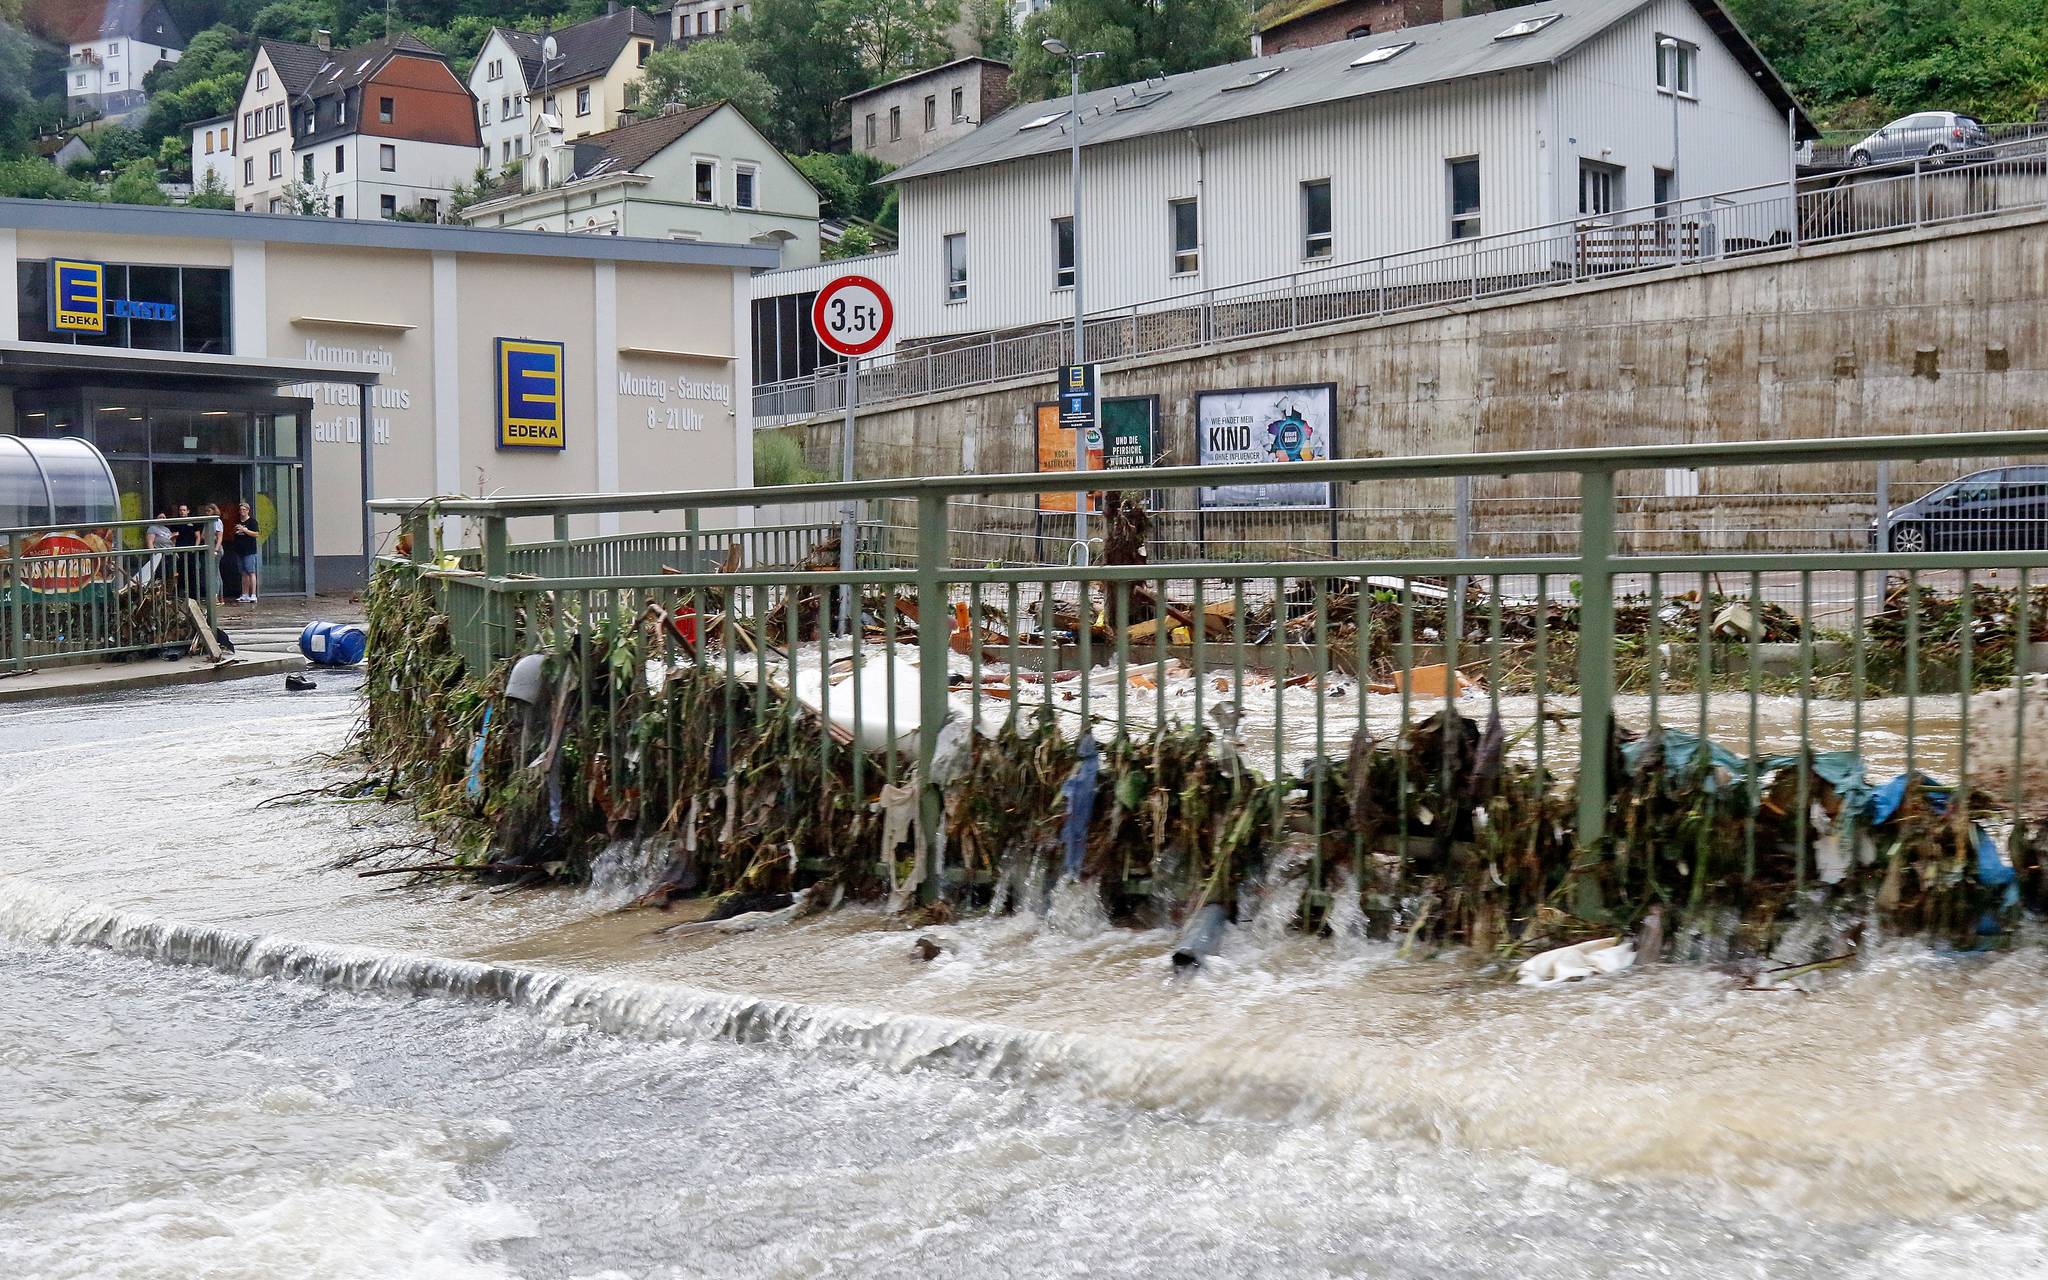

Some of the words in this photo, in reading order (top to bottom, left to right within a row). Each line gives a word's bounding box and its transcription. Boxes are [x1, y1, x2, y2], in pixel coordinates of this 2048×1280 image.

[60, 315, 99, 326] EDEKA
[305, 339, 358, 365] Komm
[362, 345, 396, 376] rein,
[619, 371, 666, 403] Montag
[678, 376, 730, 407] Samstag
[381, 388, 410, 410] uns
[647, 407, 656, 429] 8
[666, 408, 680, 430] 21
[682, 408, 704, 432] Uhr
[1211, 417, 1221, 425] WIE
[1222, 416, 1239, 425] FINDET
[1240, 415, 1254, 423] MEIN
[315, 416, 342, 443] auf
[508, 424, 558, 438] EDEKA
[1115, 436, 1128, 445] UND
[1128, 435, 1138, 444] DIE
[1209, 426, 1251, 452] KIND
[1112, 445, 1142, 455] PFIRSICHE
[1214, 452, 1229, 461] OHNE
[1229, 451, 1260, 461] INFLUENCER
[1135, 455, 1144, 464] AM
